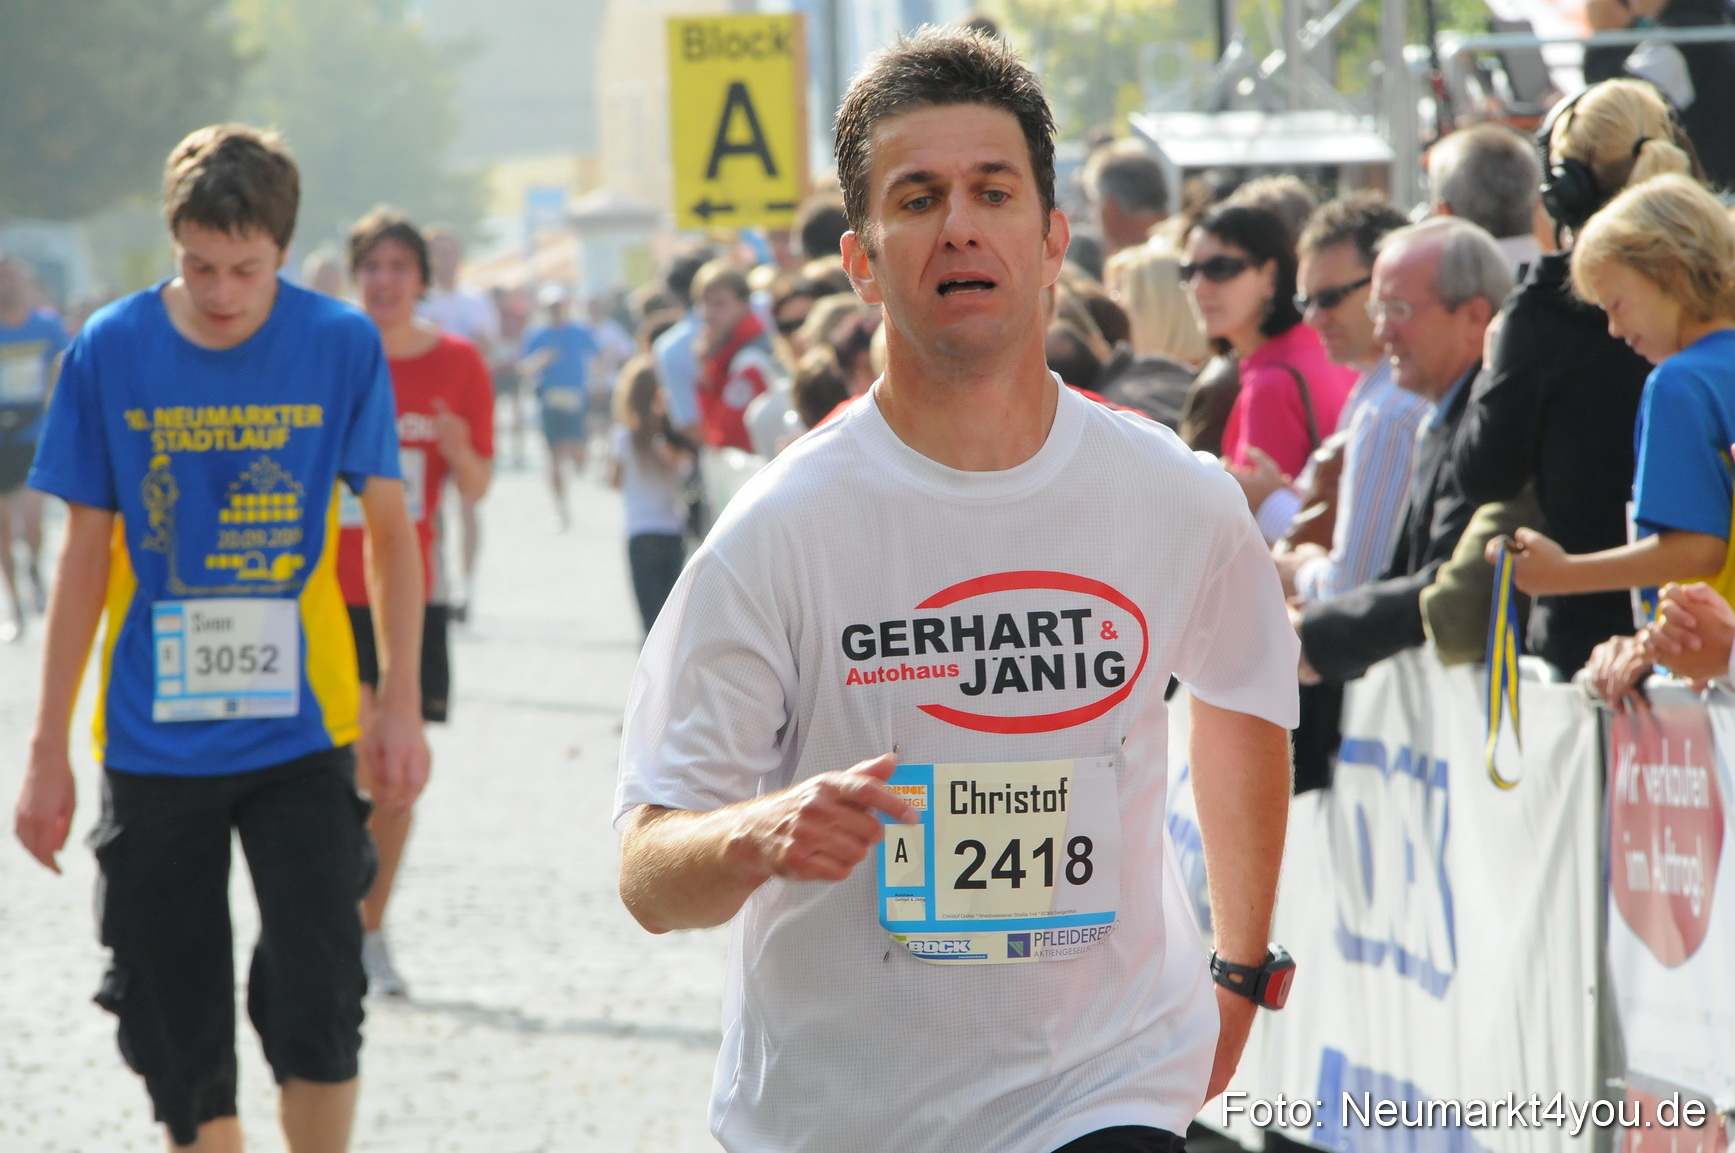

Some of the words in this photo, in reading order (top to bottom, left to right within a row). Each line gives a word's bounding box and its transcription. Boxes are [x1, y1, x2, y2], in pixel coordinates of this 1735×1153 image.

[682, 23, 792, 62] Block
[706, 81, 778, 181] A
[154, 404, 323, 429] NEUMARKTER
[152, 427, 290, 451] STADTLAUF
[192, 611, 234, 633] Sven
[842, 608, 1092, 661] GERHART
[1100, 620, 1118, 640] &
[196, 644, 280, 675] 3052
[846, 663, 960, 686] Autohaus
[959, 650, 1125, 696] JÄNIG
[1616, 743, 1639, 804] Wir
[1642, 738, 1709, 808] verkaufen
[950, 777, 1068, 814] Christof
[894, 838, 908, 863] A
[953, 836, 1093, 889] 2418
[1623, 832, 1650, 891] im
[907, 940, 971, 953] BOCK
